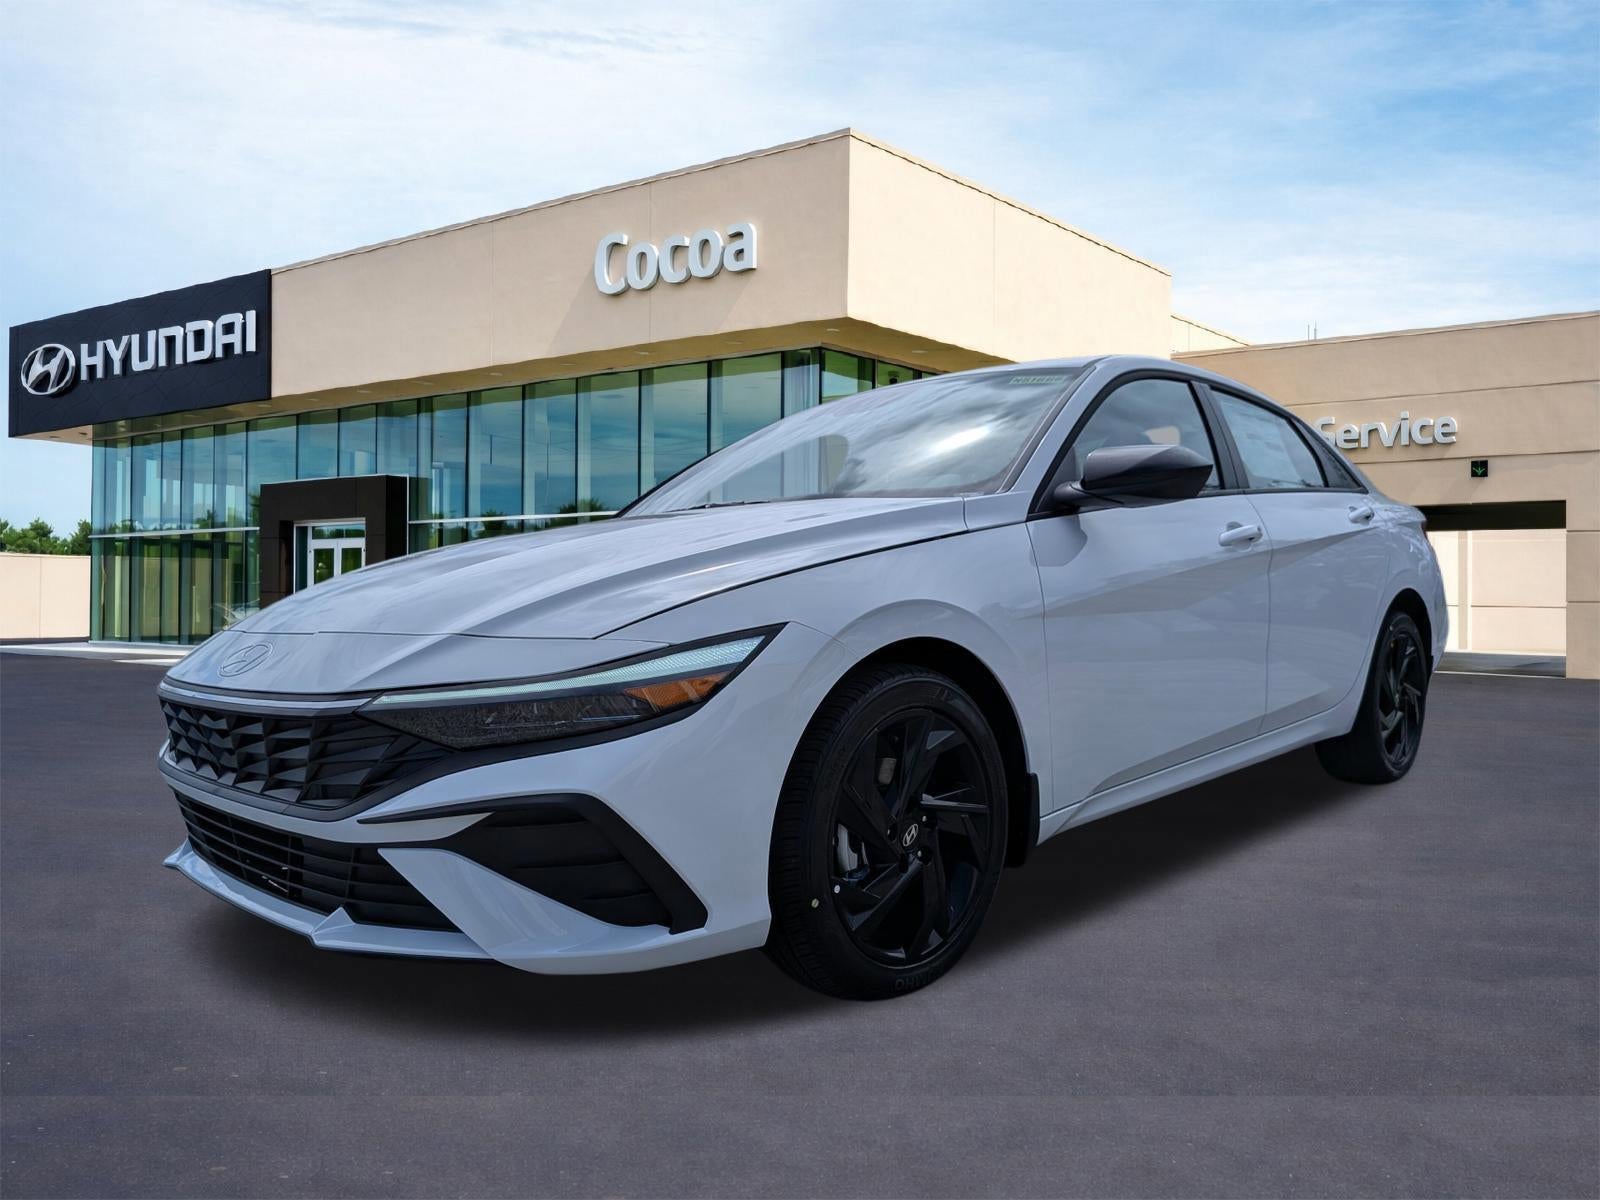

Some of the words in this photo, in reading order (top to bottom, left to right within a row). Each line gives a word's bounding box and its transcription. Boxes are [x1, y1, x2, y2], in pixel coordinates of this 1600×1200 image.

[594, 223, 757, 295] Cocoa
[80, 310, 256, 381] HYUNDAI
[1314, 411, 1458, 449] Service
